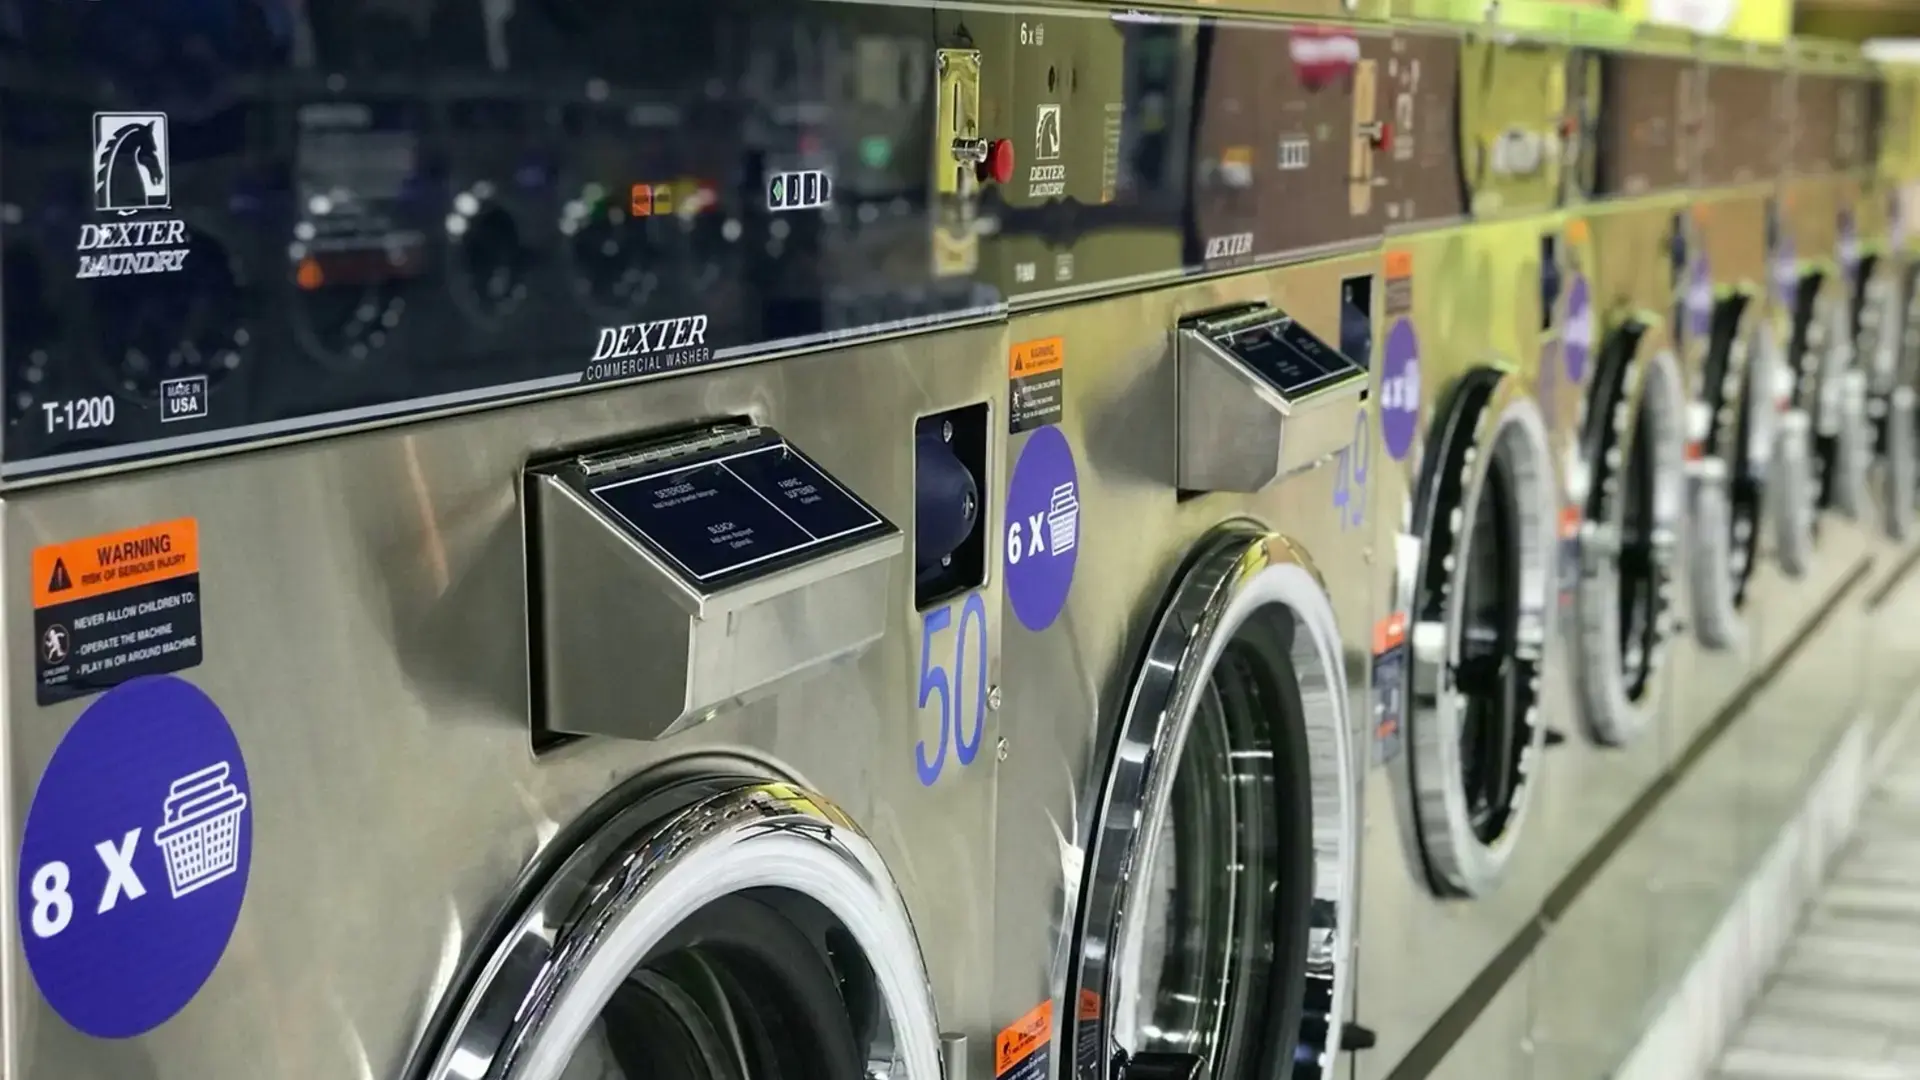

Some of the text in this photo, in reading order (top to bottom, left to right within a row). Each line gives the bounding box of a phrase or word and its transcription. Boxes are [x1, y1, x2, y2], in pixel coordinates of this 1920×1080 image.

[1020, 22, 1028, 45] 6
[1029, 165, 1066, 181] DEXTER
[77, 219, 185, 250] DEXTER
[76, 249, 190, 279] LAUNDRY
[591, 314, 708, 361] DEXTER
[586, 347, 709, 380] COMMERCIAL WASHER
[167, 382, 201, 397] MADE IN
[171, 396, 198, 414] USA
[42, 395, 115, 434] T-1200
[97, 534, 171, 566] WARNING
[1008, 511, 1045, 565] 6 X
[104, 568, 116, 581] OF
[118, 560, 155, 578] SERIOUS
[74, 613, 105, 630] NEVER
[106, 605, 137, 622] ALLOW
[138, 595, 180, 615] CHILDREN
[80, 636, 120, 656] OPERATE
[120, 631, 136, 645] THE
[137, 622, 173, 641] MACHINE
[81, 659, 103, 675] PLAY
[104, 657, 113, 669] IN
[114, 654, 126, 667] OR
[128, 644, 161, 662] AROUND
[162, 635, 197, 654] MACHINE
[915, 591, 988, 787] 50
[31, 827, 147, 938] 8 X
